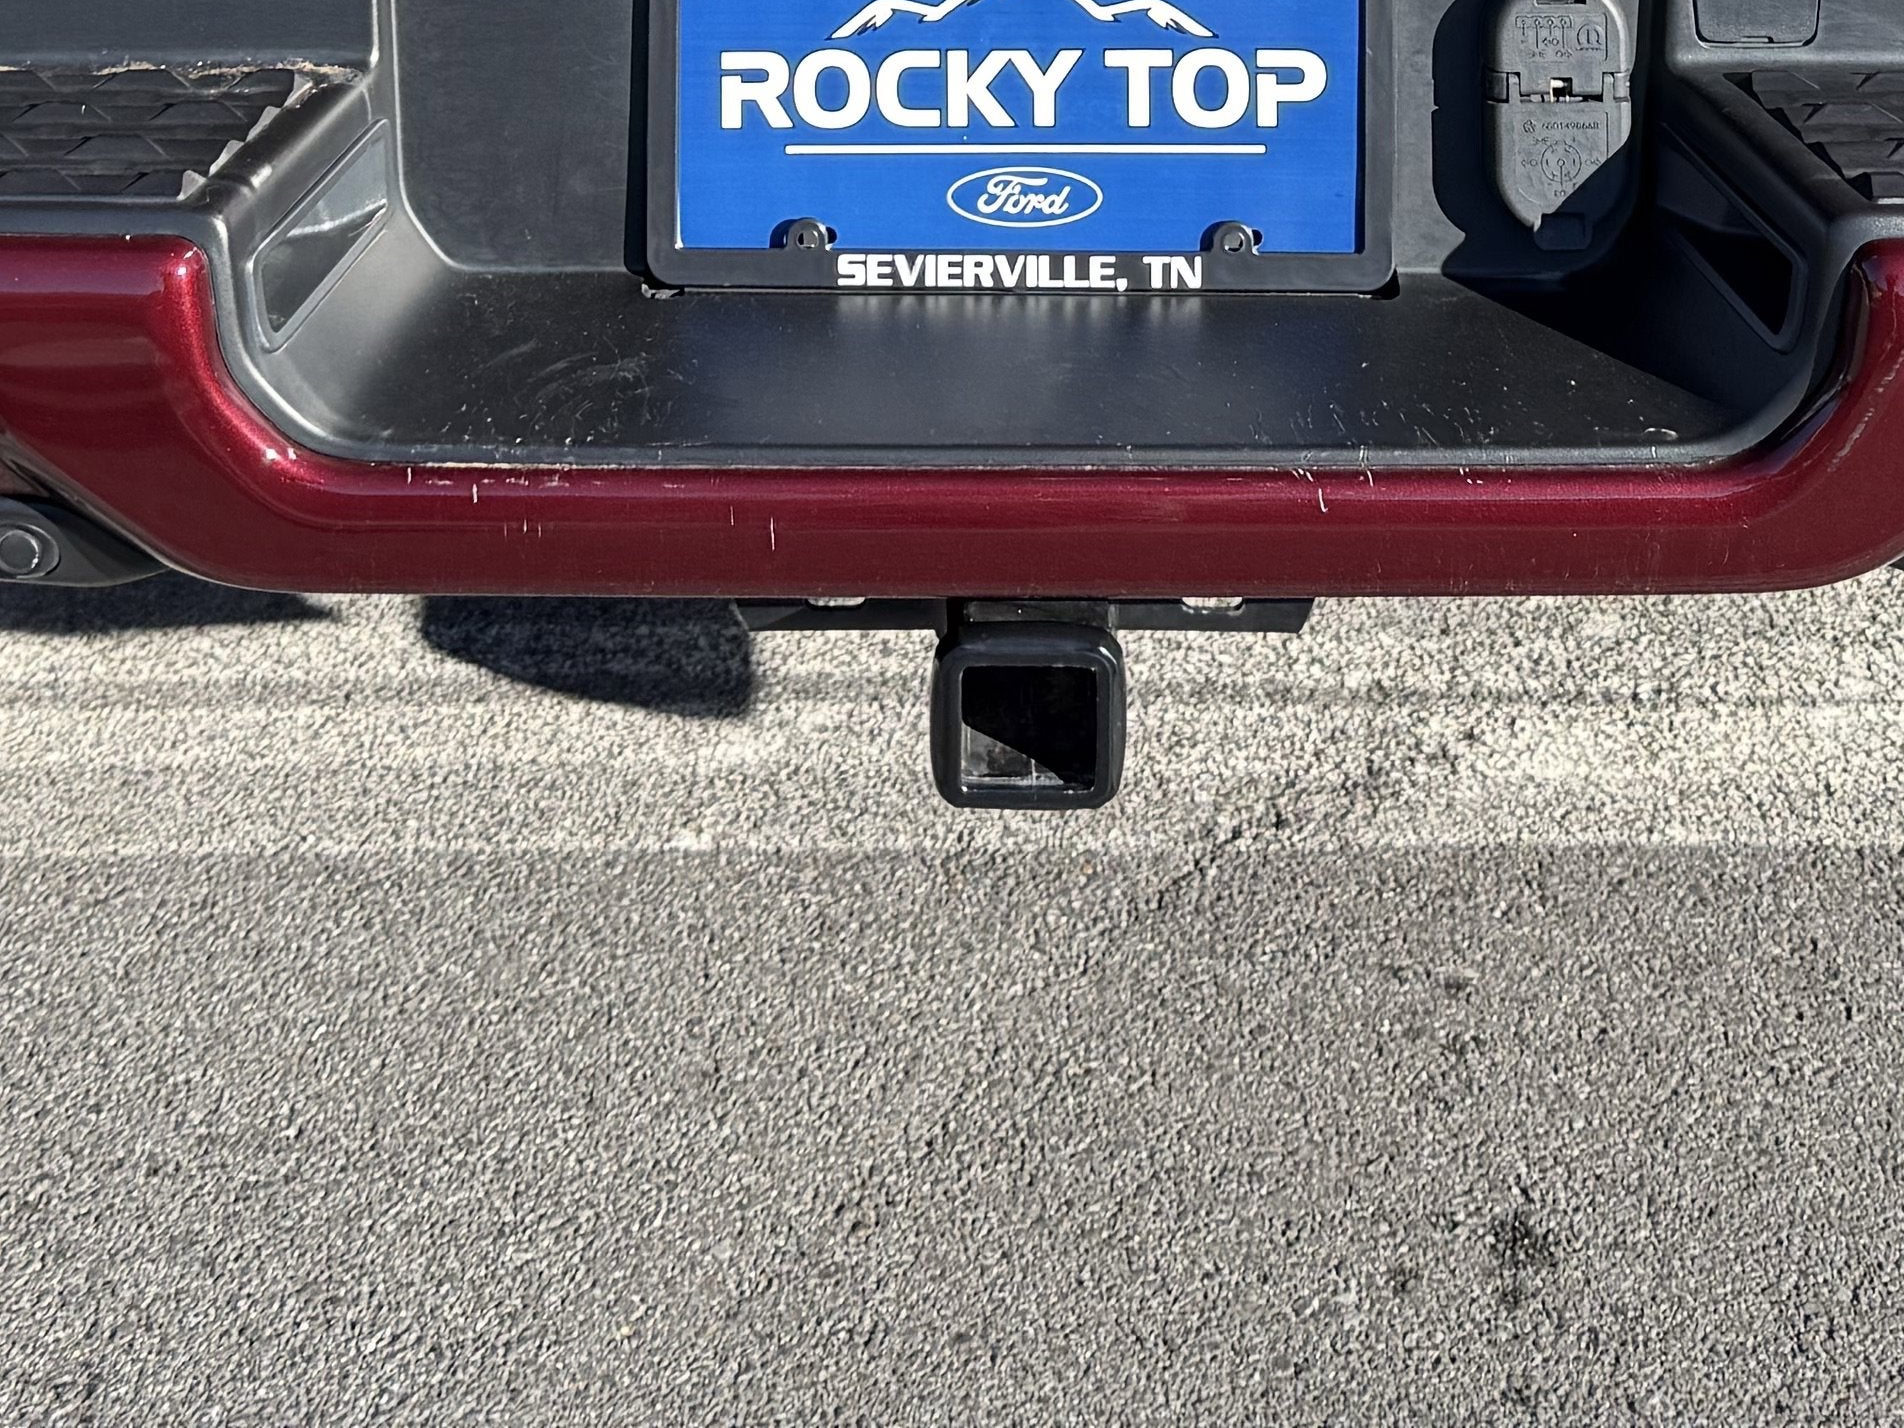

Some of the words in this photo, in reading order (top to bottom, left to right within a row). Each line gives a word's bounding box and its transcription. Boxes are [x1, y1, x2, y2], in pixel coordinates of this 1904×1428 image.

[719, 47, 1085, 130] ROCKY
[1104, 47, 1329, 130] TOP
[976, 173, 1071, 216] Ford
[836, 252, 1129, 291] SEVIERVILLE,
[1142, 253, 1203, 288] TN
